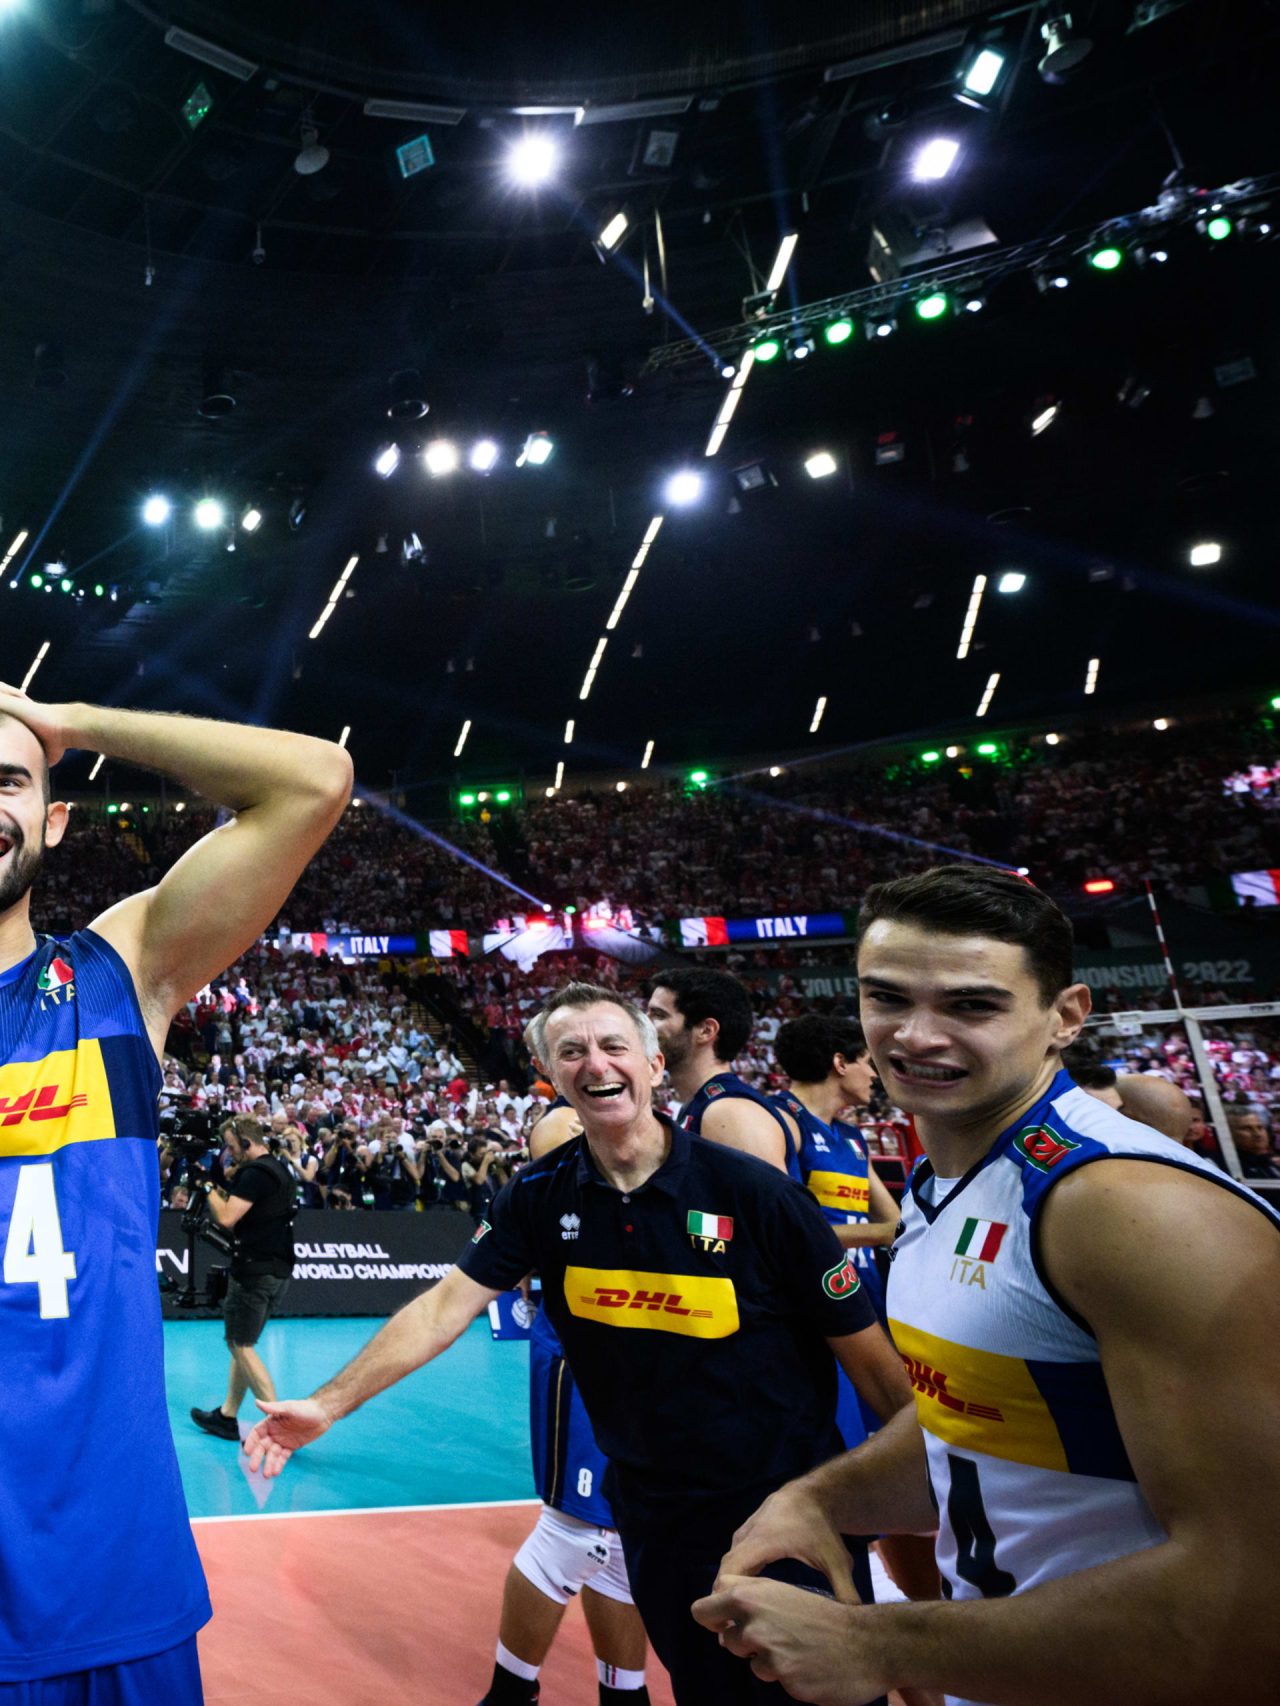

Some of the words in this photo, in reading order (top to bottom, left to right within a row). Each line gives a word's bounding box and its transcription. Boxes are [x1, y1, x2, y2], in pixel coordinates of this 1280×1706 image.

[756, 916, 808, 938] ITALY
[350, 936, 389, 955] ITALY
[293, 1243, 390, 1259] OLLEYBALL
[690, 1235, 727, 1255] ITA
[291, 1263, 354, 1279] WORLD
[950, 1258, 987, 1290] ITA
[593, 1288, 692, 1317] DHL
[576, 1467, 593, 1498] 8
